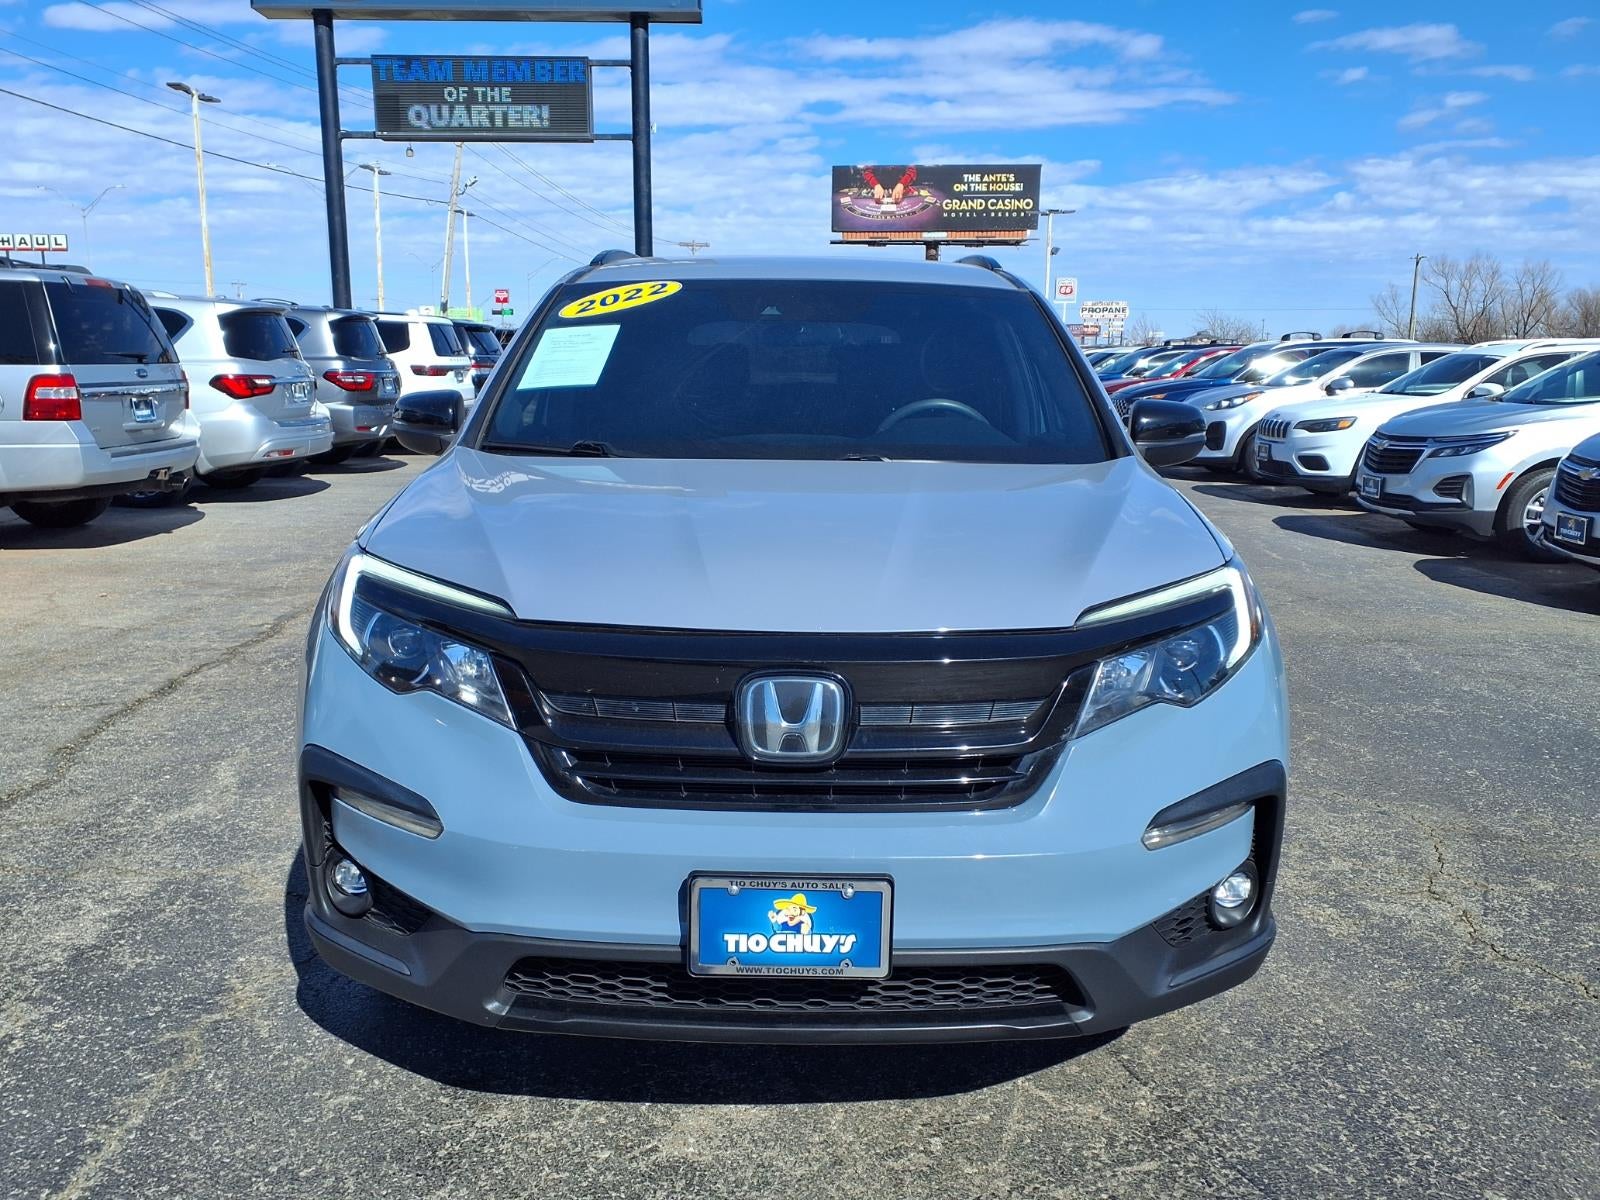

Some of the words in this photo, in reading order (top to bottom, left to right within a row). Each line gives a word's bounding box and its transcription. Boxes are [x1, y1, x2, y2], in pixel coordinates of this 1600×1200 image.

[373, 60, 453, 81] TEAM
[464, 60, 585, 82] MEMBER
[444, 87, 468, 102] OF
[474, 87, 512, 102] THE
[408, 104, 550, 129] QUARTER!
[963, 174, 981, 182] THE
[983, 174, 1015, 182] ANTE'S
[953, 183, 968, 191] ON
[969, 183, 988, 191] THE
[989, 183, 1024, 191] HOUSE!
[942, 199, 985, 210] GRAND
[987, 199, 1033, 210] CASINO
[575, 282, 669, 314] 2022
[1081, 306, 1127, 314] PROPANE
[749, 880, 787, 888] CHUY'S
[790, 881, 818, 889] AUTO
[821, 882, 855, 890] SALES
[735, 965, 845, 976] WWW.TIOCHUYS.COM
